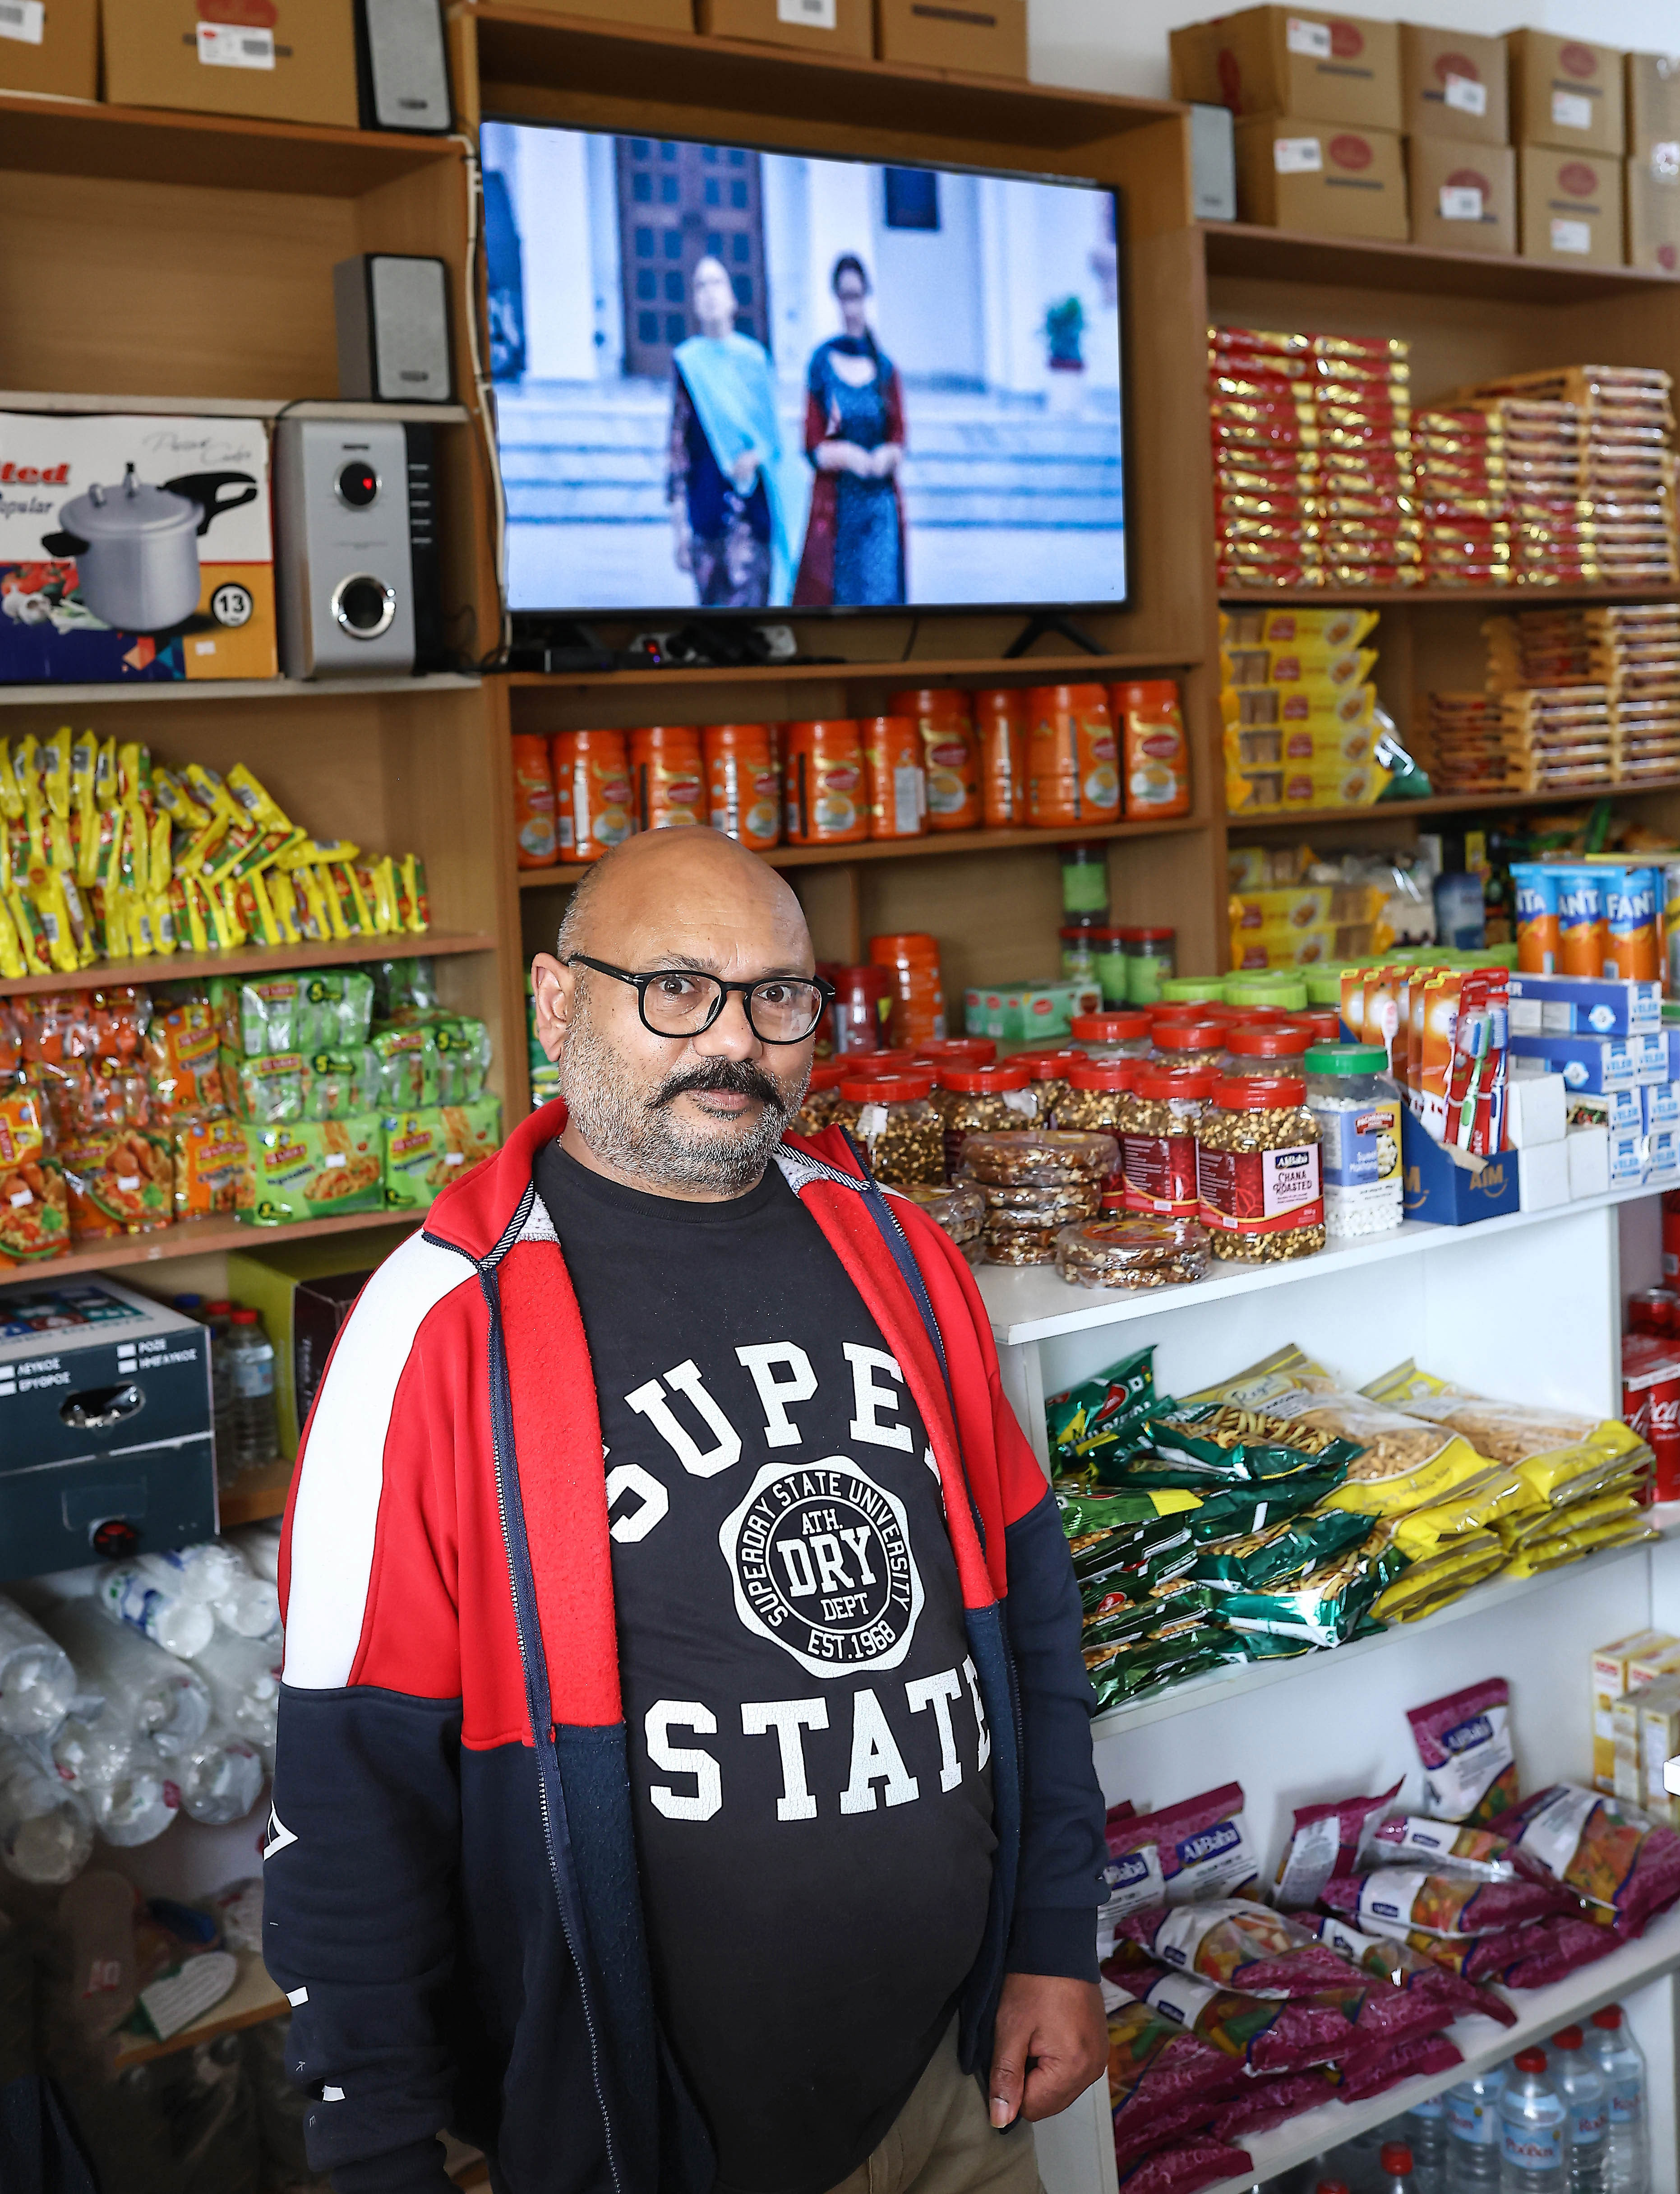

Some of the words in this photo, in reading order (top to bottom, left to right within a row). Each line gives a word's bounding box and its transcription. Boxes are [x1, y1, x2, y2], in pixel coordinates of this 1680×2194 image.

[220, 594, 244, 614] 13
[1606, 890, 1653, 921] FAN
[1273, 1180, 1312, 1195] ROASTED
[1278, 1170, 1306, 1183] CHANA
[1469, 1164, 1504, 1191] AIM
[603, 1341, 946, 1543] SUPE
[802, 1508, 844, 1535] ATH.
[742, 1497, 788, 1627] SUPERDRY
[772, 1472, 841, 1506] STATE
[849, 1479, 910, 1612] UNIVERSITY
[776, 1525, 877, 1597] DRY
[820, 1592, 869, 1621] DEPT
[1185, 1829, 1239, 1862] AliBaba
